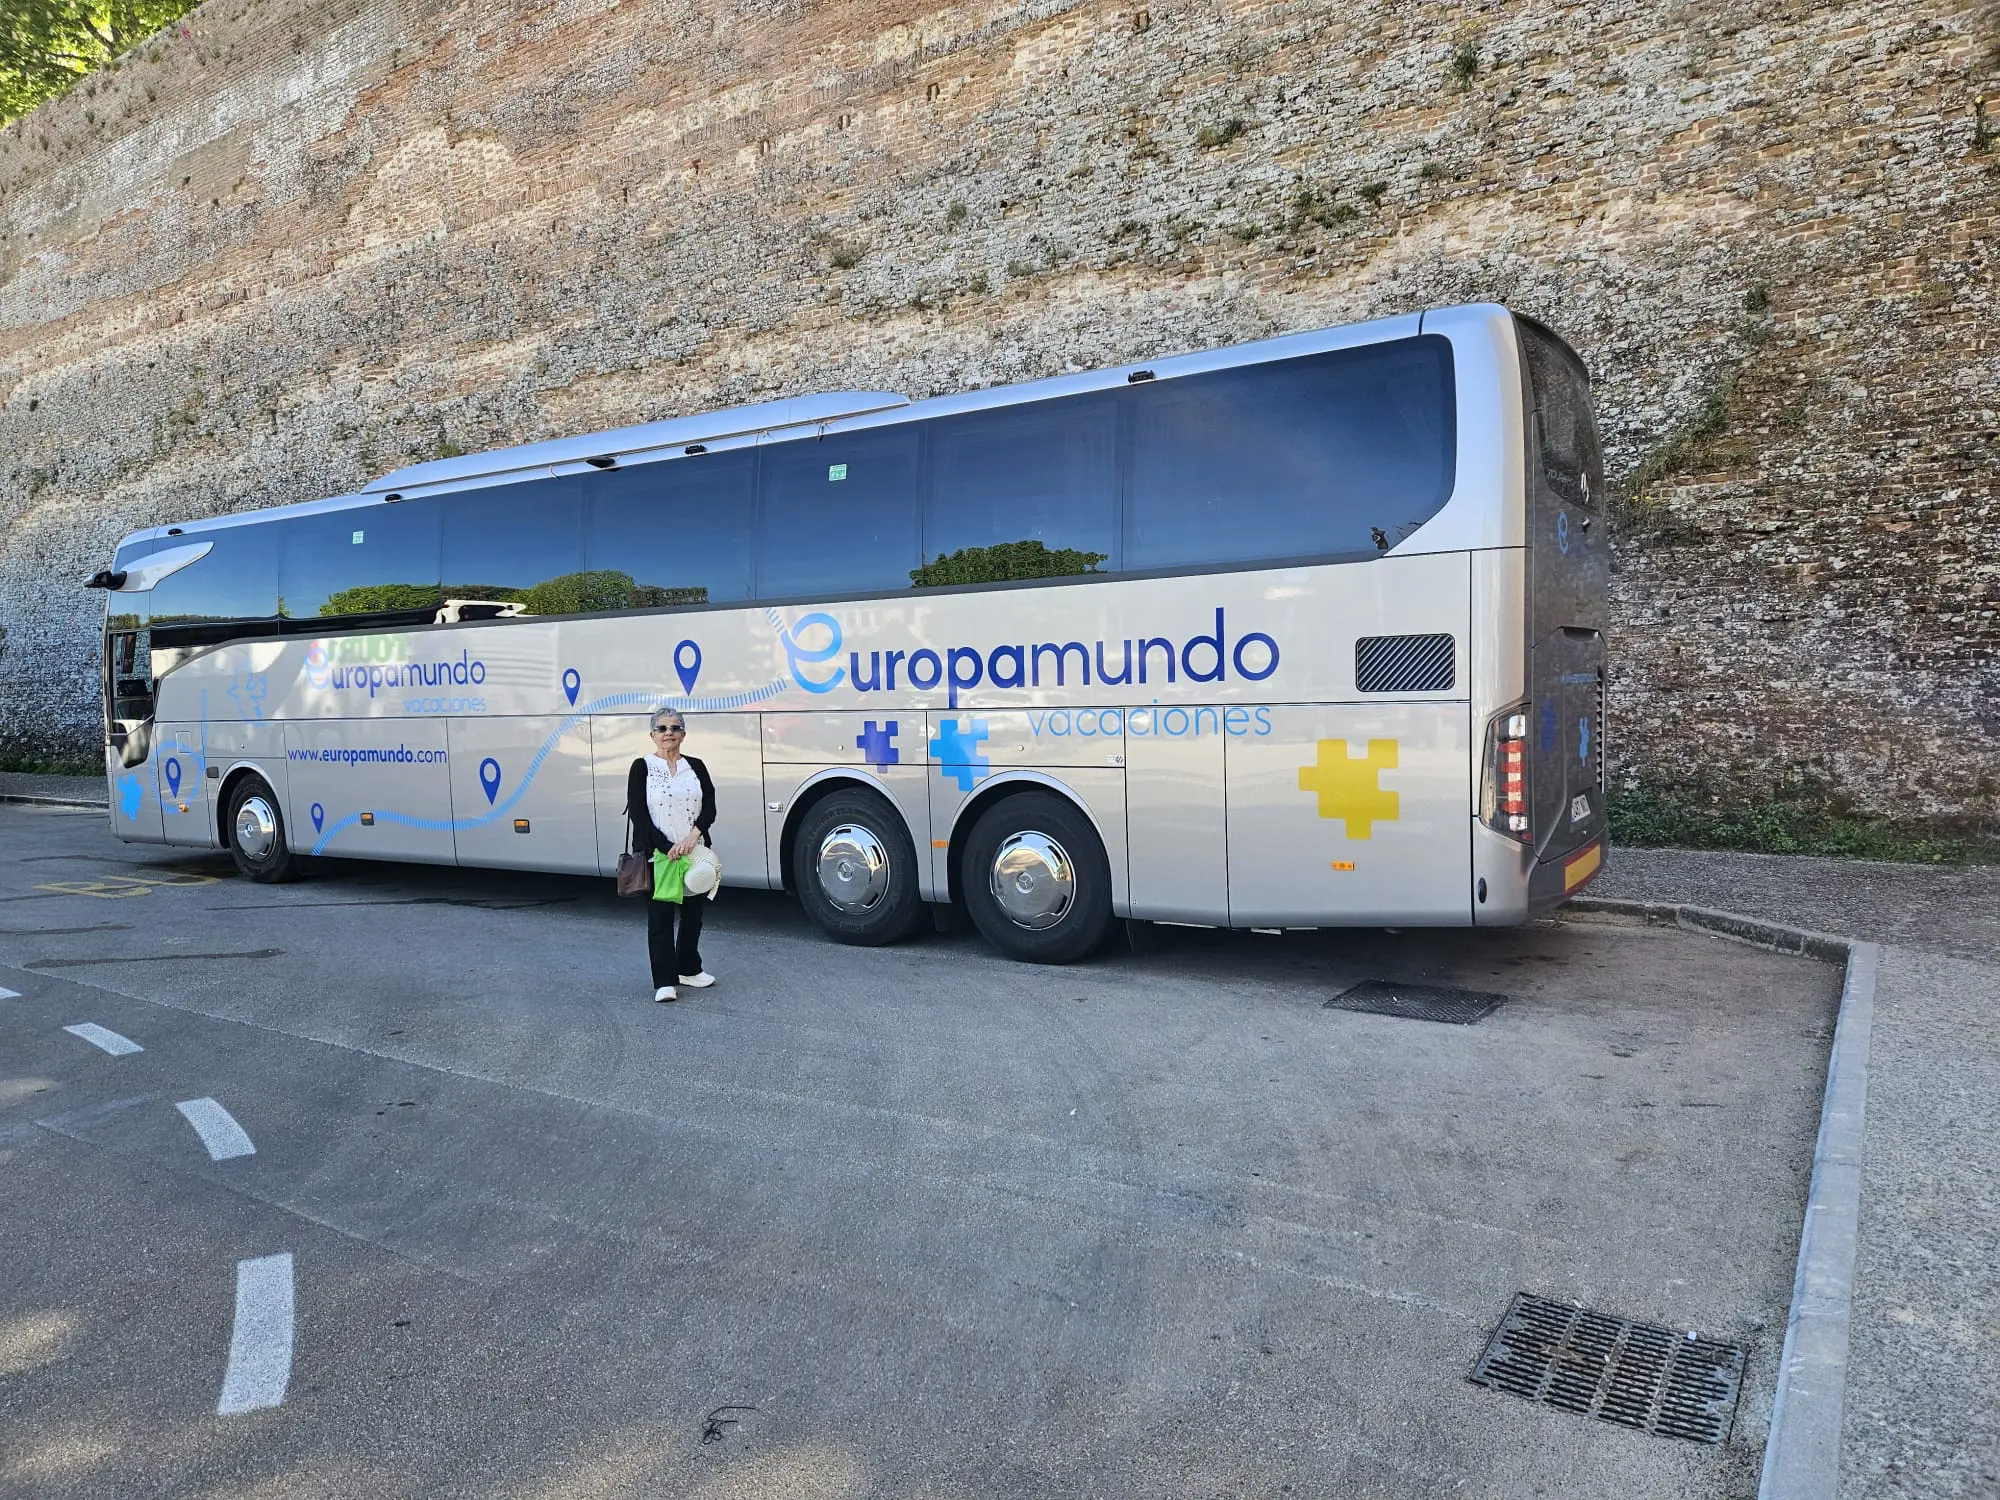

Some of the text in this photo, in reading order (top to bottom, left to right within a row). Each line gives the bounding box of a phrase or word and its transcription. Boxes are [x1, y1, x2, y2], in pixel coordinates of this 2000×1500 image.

[305, 648, 486, 697] europamundo
[781, 606, 1280, 709] europamundo
[404, 698, 487, 713] vacaciones
[1026, 699, 1272, 736] vacaciones
[287, 744, 447, 767] www.europamundo.com
